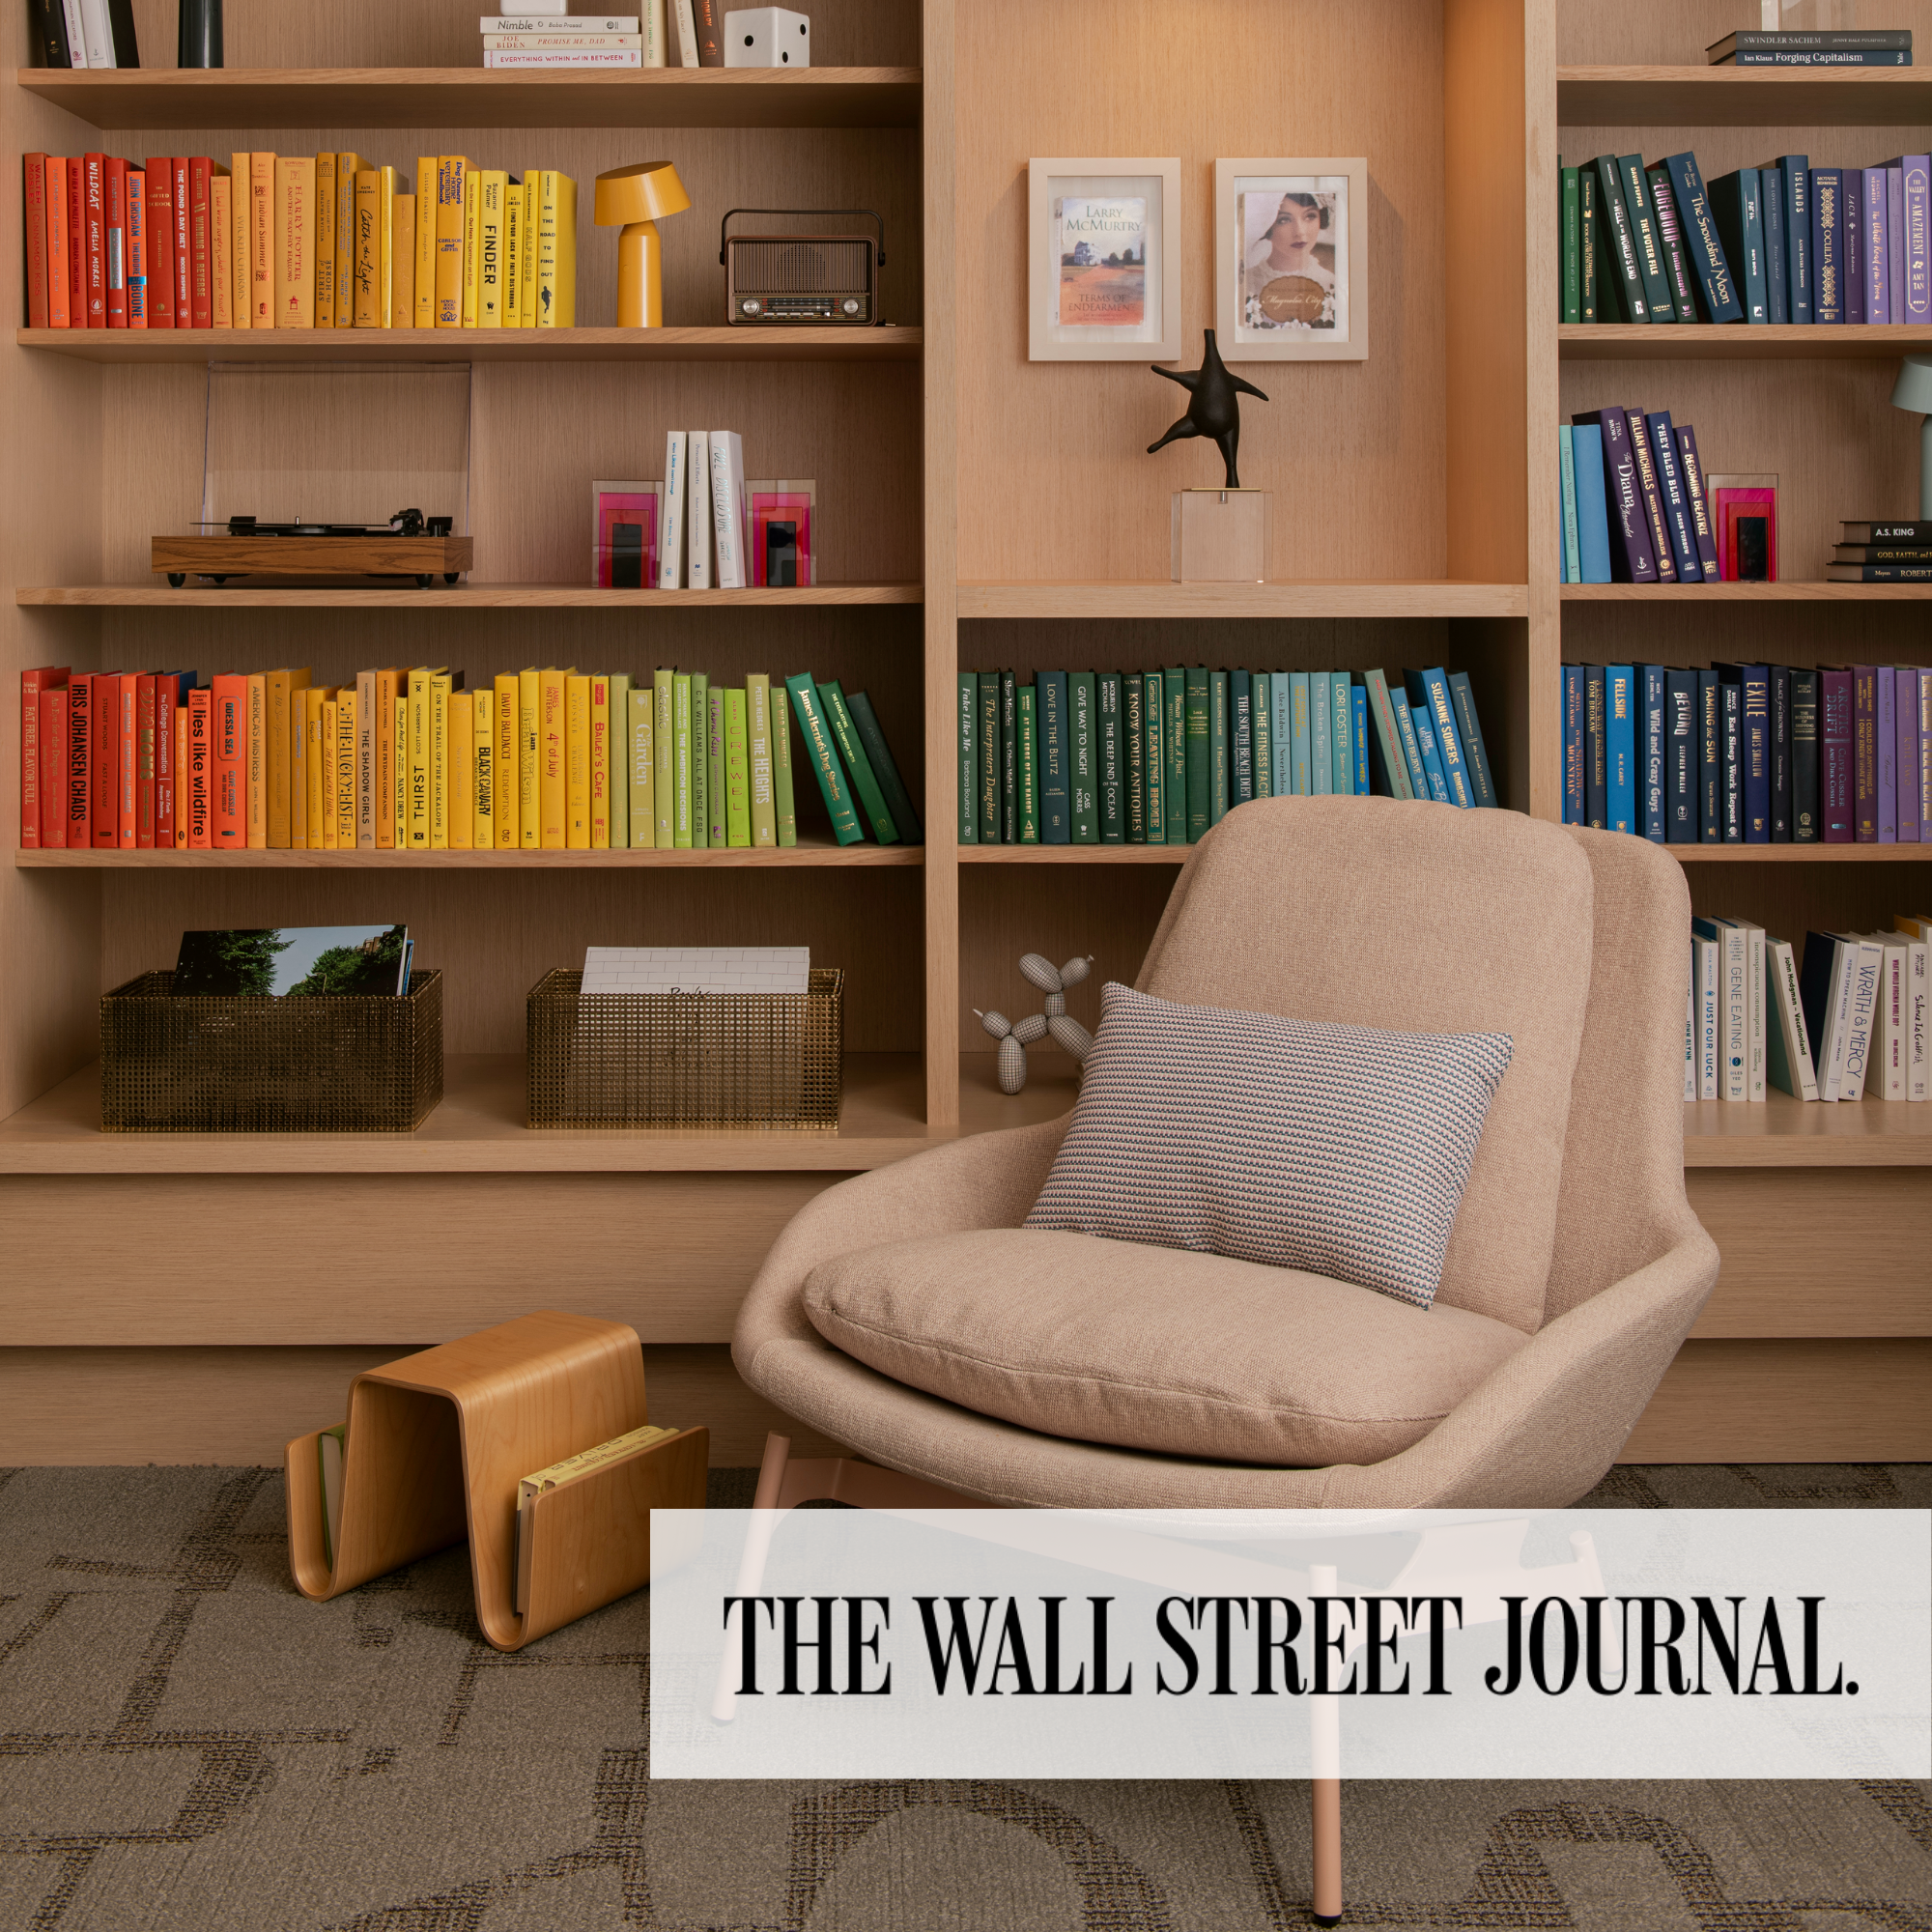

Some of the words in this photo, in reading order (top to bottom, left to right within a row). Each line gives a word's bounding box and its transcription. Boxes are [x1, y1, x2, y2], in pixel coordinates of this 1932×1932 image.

[497, 20, 533, 30] Nimble
[1776, 53, 1810, 64] Forging
[1813, 53, 1862, 62] Capitalism
[89, 162, 99, 210] WILDCAT
[129, 177, 140, 198] JOHN
[1634, 185, 1643, 207] PEPPER
[1795, 172, 1804, 213] ISLANDS
[130, 202, 141, 237] GRISHAM
[1653, 184, 1680, 242] EDGEWOOD
[1691, 193, 1704, 216] The
[196, 216, 205, 249] WINNING
[361, 210, 373, 243] Catch
[1697, 217, 1721, 267] Snowblind
[1913, 204, 1923, 255] AMAZEMENT
[485, 225, 497, 284] FINDER
[1643, 235, 1654, 259] VOTER
[1649, 260, 1658, 275] FILE
[356, 261, 373, 295] Light
[1710, 270, 1730, 304] Moon
[131, 286, 143, 319] BOONE
[1608, 419, 1617, 441] BROWN
[1631, 416, 1644, 446] JILLIAN
[1657, 424, 1669, 449] THEY
[714, 446, 726, 469] FULL
[1637, 448, 1654, 490] MICHAELS
[1662, 452, 1674, 476] BLED
[1618, 464, 1635, 507] Diana
[1668, 480, 1680, 504] BLUE
[1684, 454, 1701, 497] BECOMING
[715, 477, 731, 534] DISCLOSURE
[1692, 500, 1708, 536] BEATRIZ
[72, 685, 87, 707] IRIS
[252, 686, 261, 736] AMERICA'S
[501, 693, 510, 717] DAVID
[798, 689, 817, 717] James
[1336, 684, 1346, 706] LORI
[1615, 679, 1626, 719] FELLSIDE
[1706, 686, 1715, 725] TAMING
[1747, 682, 1766, 717] EXILE
[25, 706, 35, 723] FAT
[193, 710, 206, 737] lies
[225, 702, 234, 735] ODESSA
[1128, 694, 1139, 730] KNOW
[1337, 709, 1347, 748] FOSTER
[1431, 682, 1449, 724] SUZANNE
[1441, 726, 1459, 764] SOMERS
[1650, 709, 1660, 733] Wild
[1673, 693, 1691, 735] BEYOND
[24, 724, 35, 747] FREE,
[71, 712, 87, 777] JOHANSEN
[225, 739, 234, 754] SEA
[501, 721, 510, 759] BALDACCI
[547, 733, 559, 746] 4th
[753, 738, 765, 755] THE
[807, 716, 826, 753] Herriot's
[1079, 732, 1086, 745] TO
[1651, 736, 1660, 754] and
[1706, 727, 1715, 738] the
[25, 749, 35, 781] FLAVOR
[193, 743, 206, 771] like
[252, 739, 261, 781] MISTRESS
[478, 747, 491, 778] BLACK
[549, 749, 557, 757] of
[820, 752, 833, 771] Dog
[1129, 734, 1140, 767] YOUR
[1150, 725, 1158, 783] LEAVING
[1707, 741, 1716, 762] SUN
[546, 759, 558, 778] July
[754, 758, 769, 804] HEIGHTS
[1649, 757, 1661, 784] Crazy
[25, 783, 35, 805] FULL
[71, 781, 86, 820] CHAOS
[413, 765, 424, 819] THIRST
[478, 779, 491, 815] CANARY
[826, 771, 840, 801] Stories
[1131, 772, 1141, 831] ANTIQUES
[1649, 787, 1661, 812] Guys
[193, 776, 207, 836] wildfire
[1151, 787, 1159, 827] HOME
[1731, 967, 1741, 1001] GENE
[1855, 965, 1876, 1012] WRATH
[1731, 1006, 1742, 1049] EATING
[1786, 974, 1798, 1006] Hodgman
[1794, 1013, 1806, 1055] Vacationland
[1855, 1016, 1866, 1026] &
[1846, 1031, 1866, 1078] MERCY
